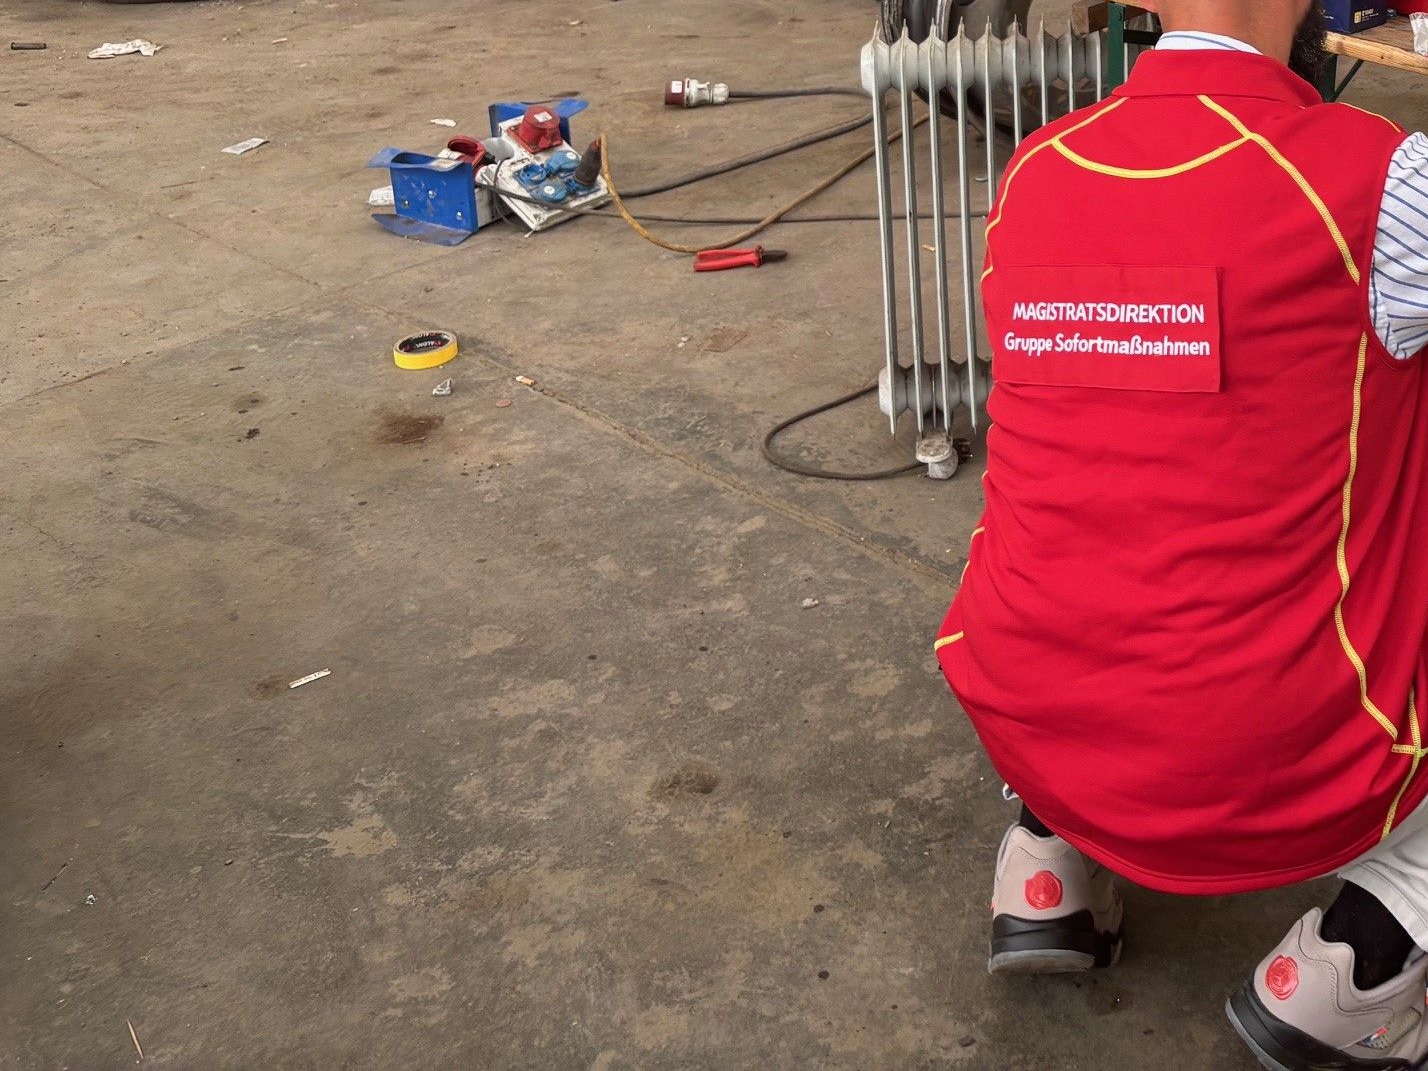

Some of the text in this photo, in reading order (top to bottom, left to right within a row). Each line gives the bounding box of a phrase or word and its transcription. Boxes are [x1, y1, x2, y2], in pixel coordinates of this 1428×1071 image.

[1012, 302, 1205, 324] MAGISTRATSDIREKTION
[1004, 332, 1211, 357] Gruppe Sofortmaßnahmen
